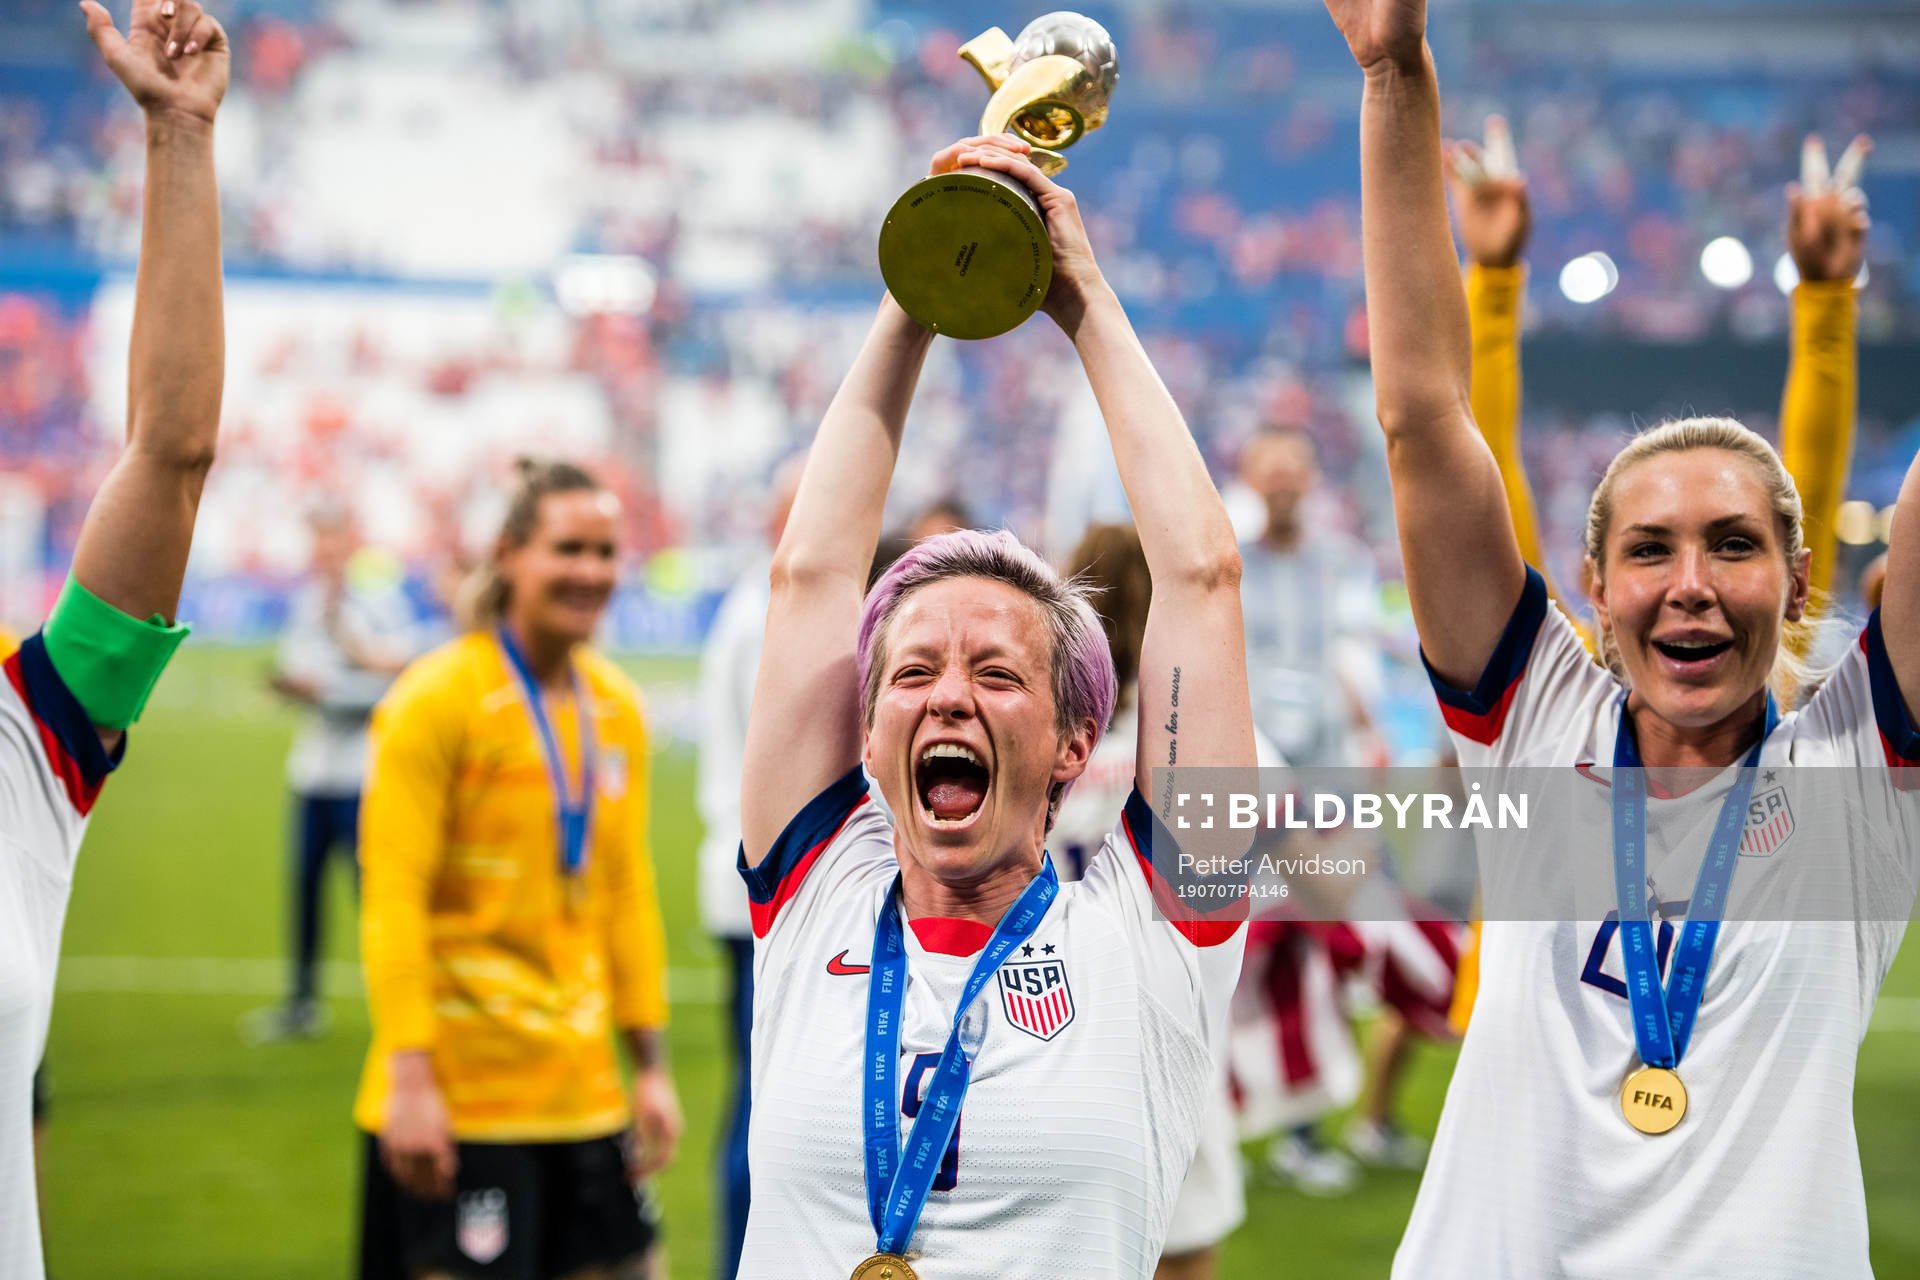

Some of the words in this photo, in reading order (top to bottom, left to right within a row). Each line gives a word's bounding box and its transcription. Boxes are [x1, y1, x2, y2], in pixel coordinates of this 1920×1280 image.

[955, 244, 969, 268] WORLD
[959, 241, 979, 278] CHAMPIONS
[1171, 666, 1182, 708] course
[1165, 711, 1179, 735] her
[1168, 739, 1178, 767] ran
[1163, 771, 1176, 820] nature
[1745, 793, 1782, 826] SA
[1003, 965, 1062, 996] USA
[1633, 1090, 1674, 1111] FIFA
[895, 1190, 914, 1217] FIFA
